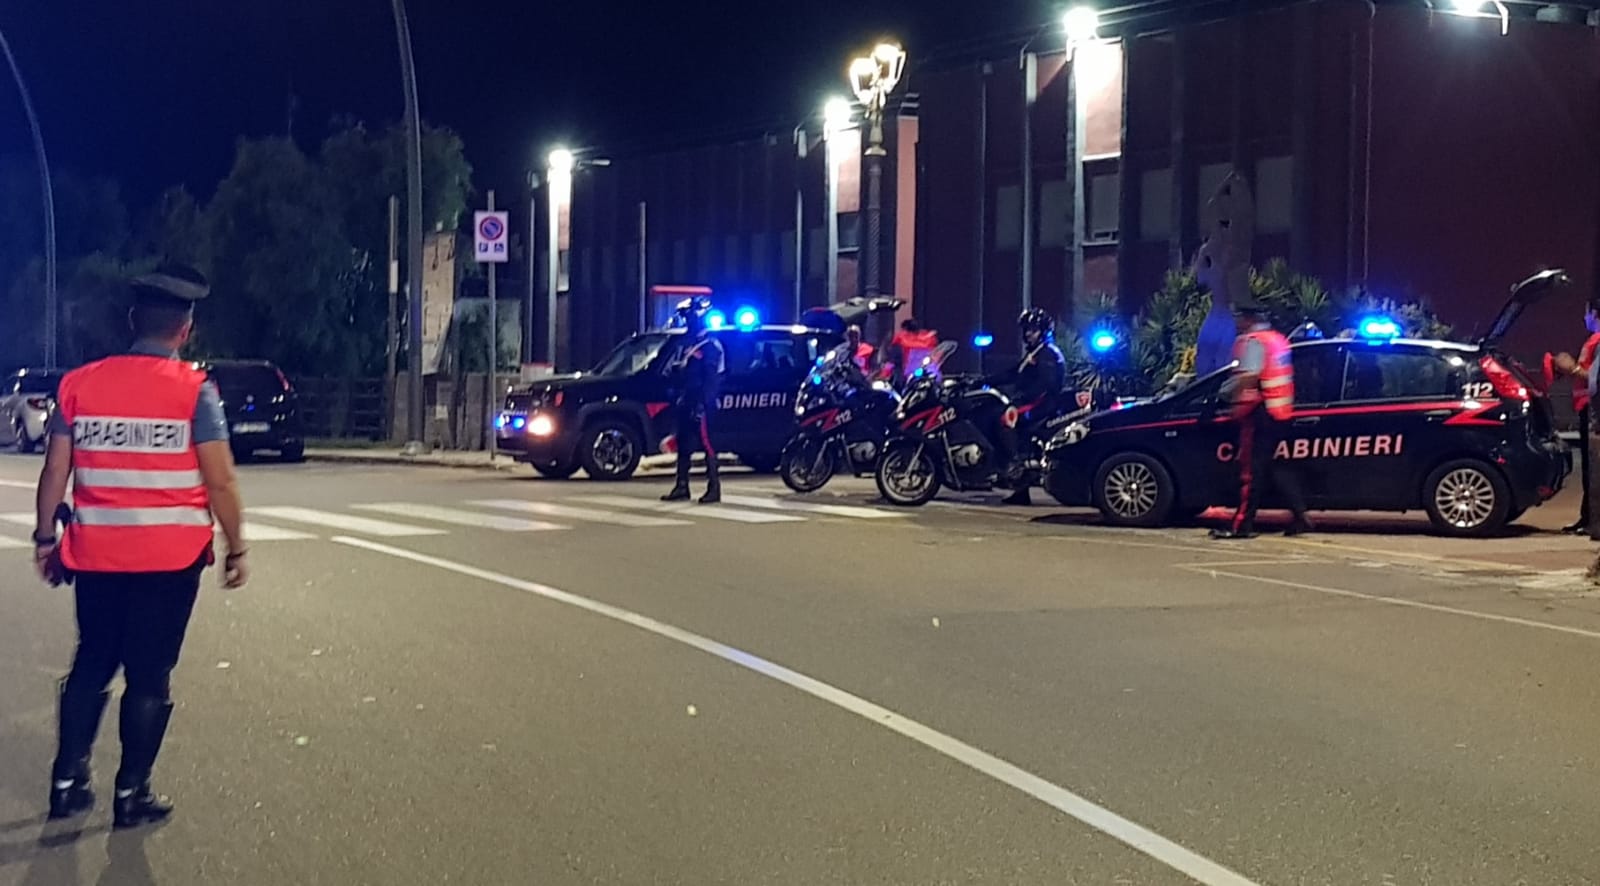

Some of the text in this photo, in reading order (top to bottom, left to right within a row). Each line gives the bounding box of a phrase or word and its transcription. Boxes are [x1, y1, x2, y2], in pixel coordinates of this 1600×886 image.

[1462, 382, 1494, 399] 112
[835, 409, 853, 425] 112
[937, 407, 957, 425] 112
[73, 420, 186, 449] CARABINIERI
[1216, 433, 1404, 462] CABINIERI
